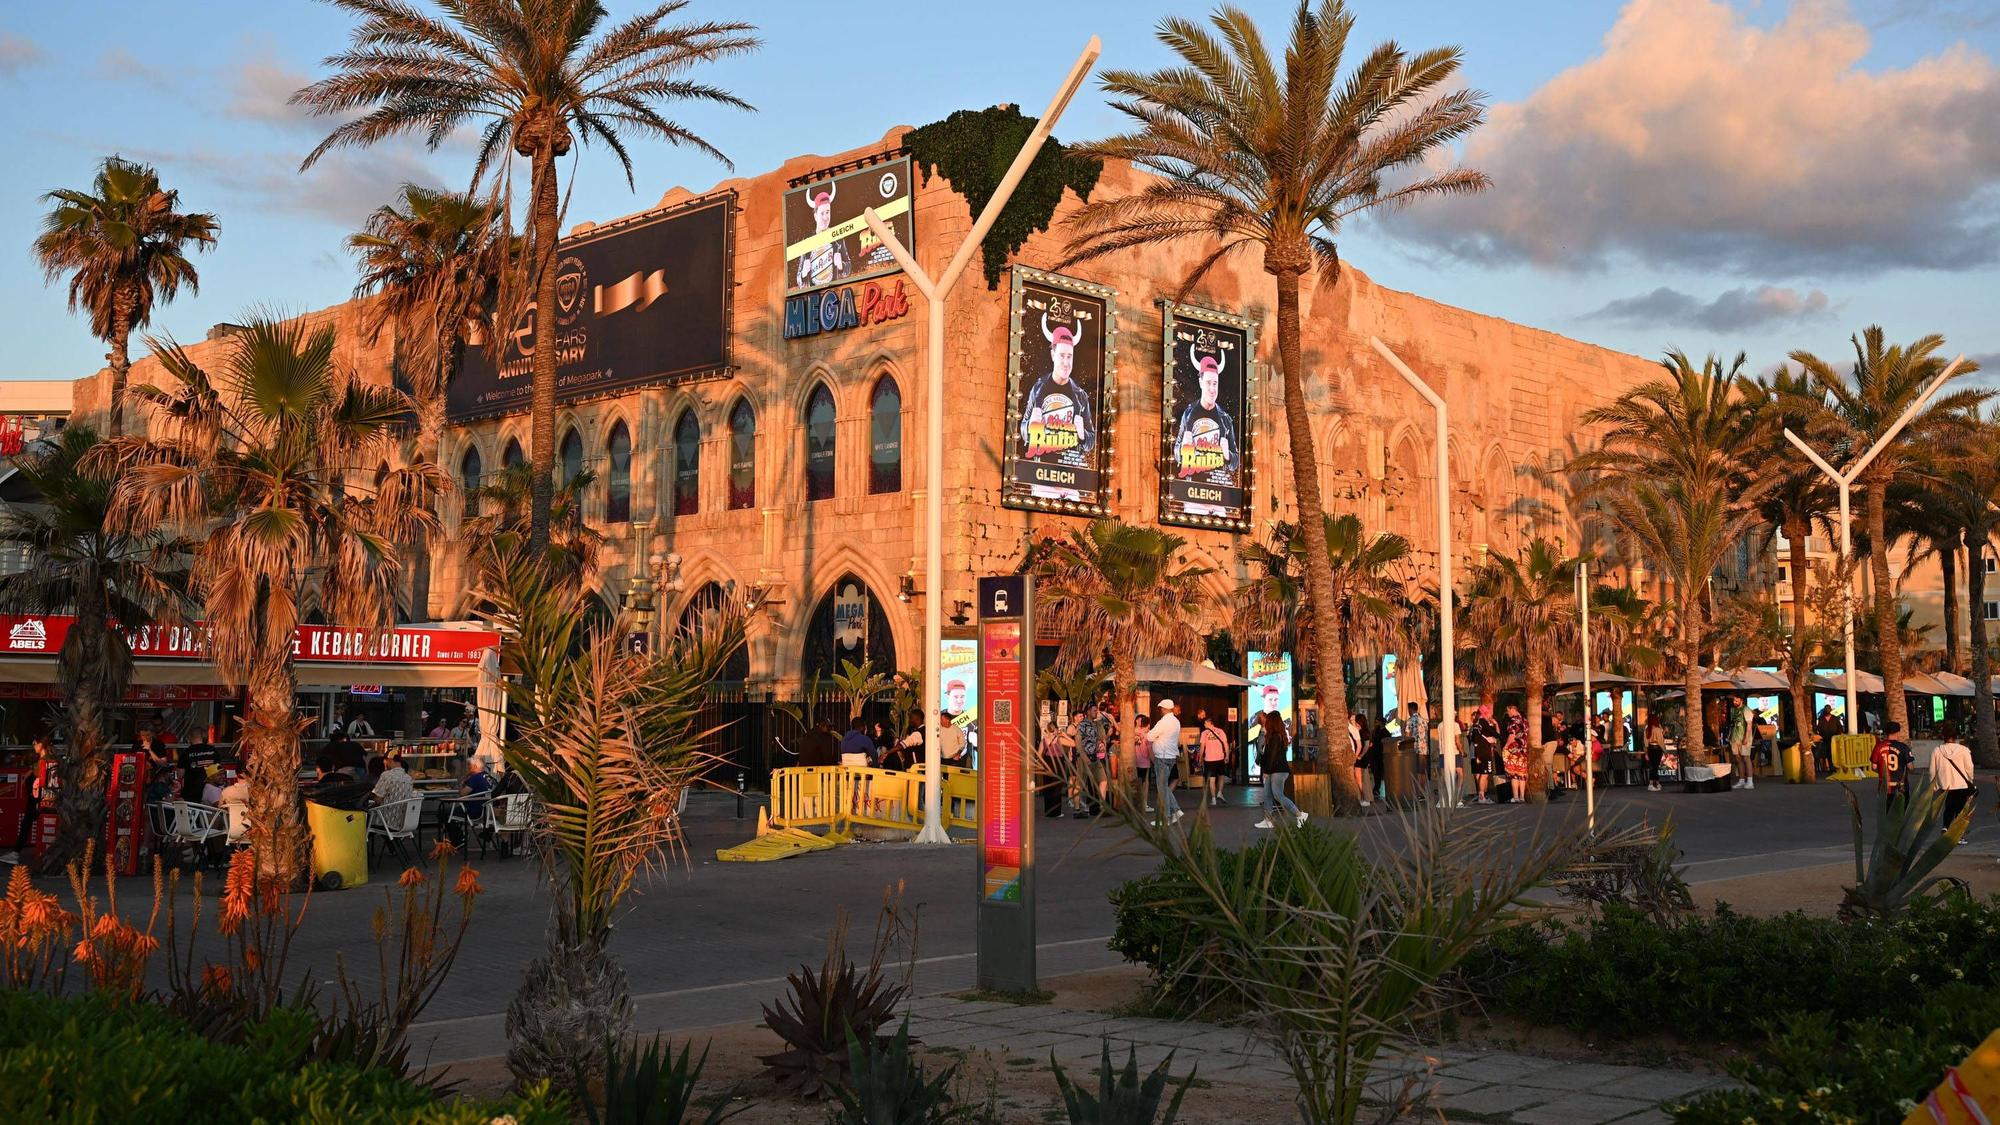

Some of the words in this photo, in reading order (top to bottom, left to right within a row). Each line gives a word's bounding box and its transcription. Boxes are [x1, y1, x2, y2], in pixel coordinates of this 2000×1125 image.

[831, 223, 854, 238] GLEICH
[784, 287, 858, 339] MEGA
[859, 279, 911, 327] Park
[555, 326, 587, 347] EARS
[498, 345, 587, 380] ANNIVSARY
[485, 388, 516, 401] Welcome
[558, 375, 566, 386] of
[567, 369, 602, 384] Megapark
[1036, 468, 1075, 484] GLEICH
[1187, 486, 1222, 502] GLEICH
[836, 603, 864, 618] MEGA
[9, 640, 45, 649] ABEL'S
[311, 631, 363, 656] KEBAB
[467, 652, 482, 660] 1983
[352, 684, 379, 693] PIZZA
[1881, 752, 1898, 771] 19
